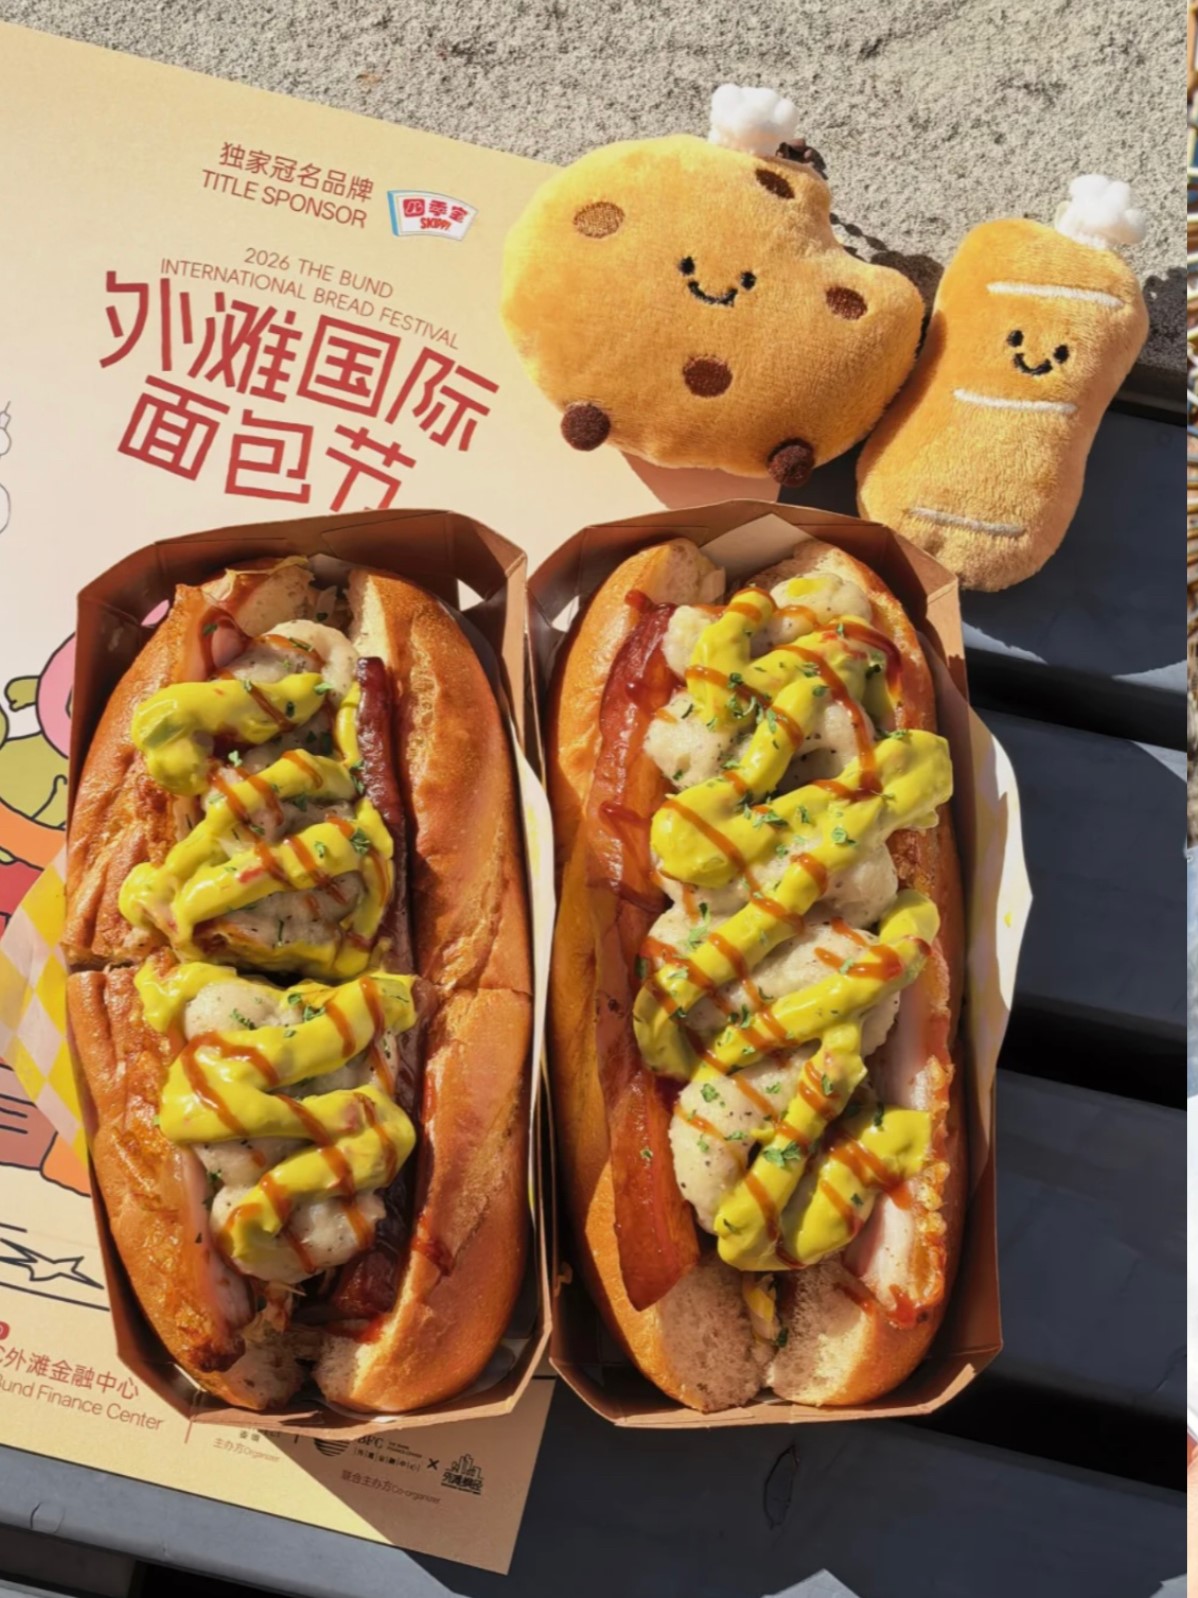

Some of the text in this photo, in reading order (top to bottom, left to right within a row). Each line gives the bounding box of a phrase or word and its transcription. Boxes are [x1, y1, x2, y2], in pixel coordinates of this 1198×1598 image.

[202, 169, 367, 229] TITLE SPONSOR
[219, 141, 374, 202] 独家冠名品牌
[244, 247, 394, 299] 2026 THE BUND
[160, 258, 460, 350] INTERNATIONAL BREAD FESTIVAL
[99, 270, 500, 452] 外滩国际
[117, 374, 417, 512] 面包节
[0, 1374, 166, 1431] und Finance Center
